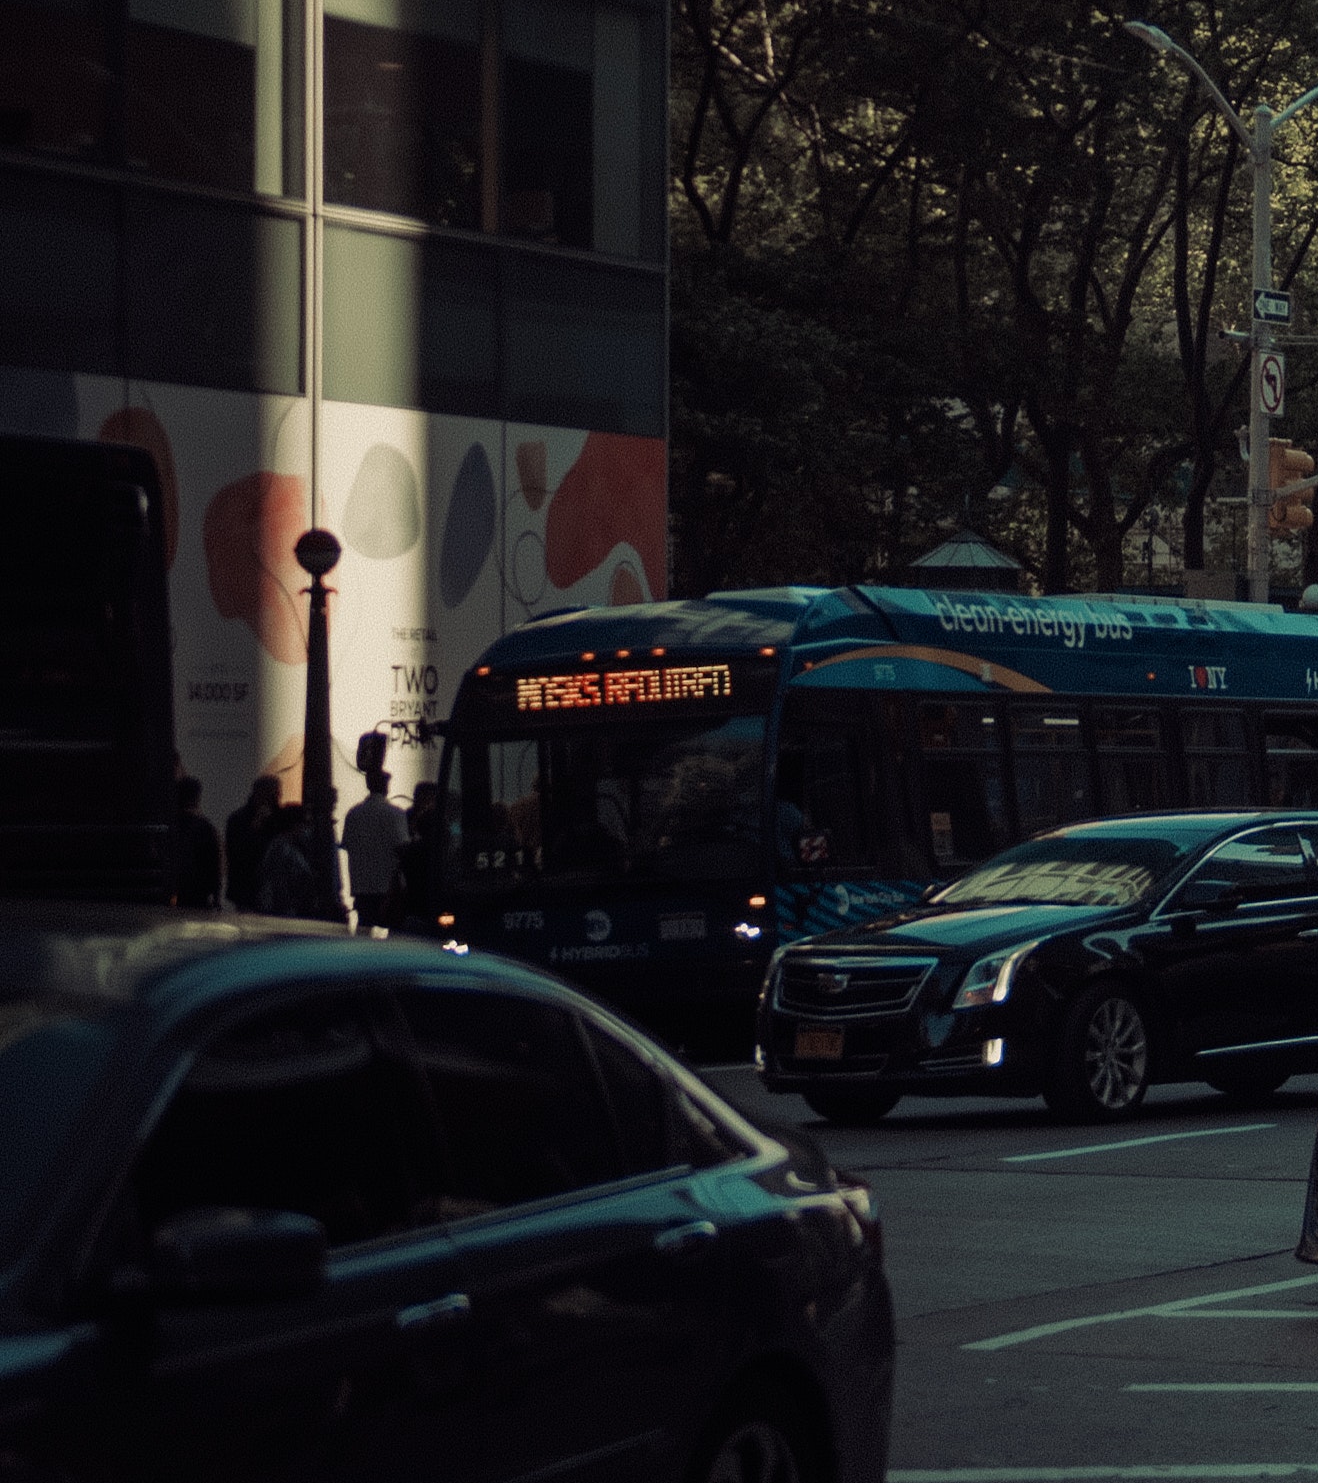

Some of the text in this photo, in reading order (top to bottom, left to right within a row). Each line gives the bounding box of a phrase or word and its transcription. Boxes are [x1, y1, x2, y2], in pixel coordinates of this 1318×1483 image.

[937, 596, 1134, 649] clean-energy bus
[391, 665, 438, 695] TWO
[391, 700, 438, 717] BRYANT
